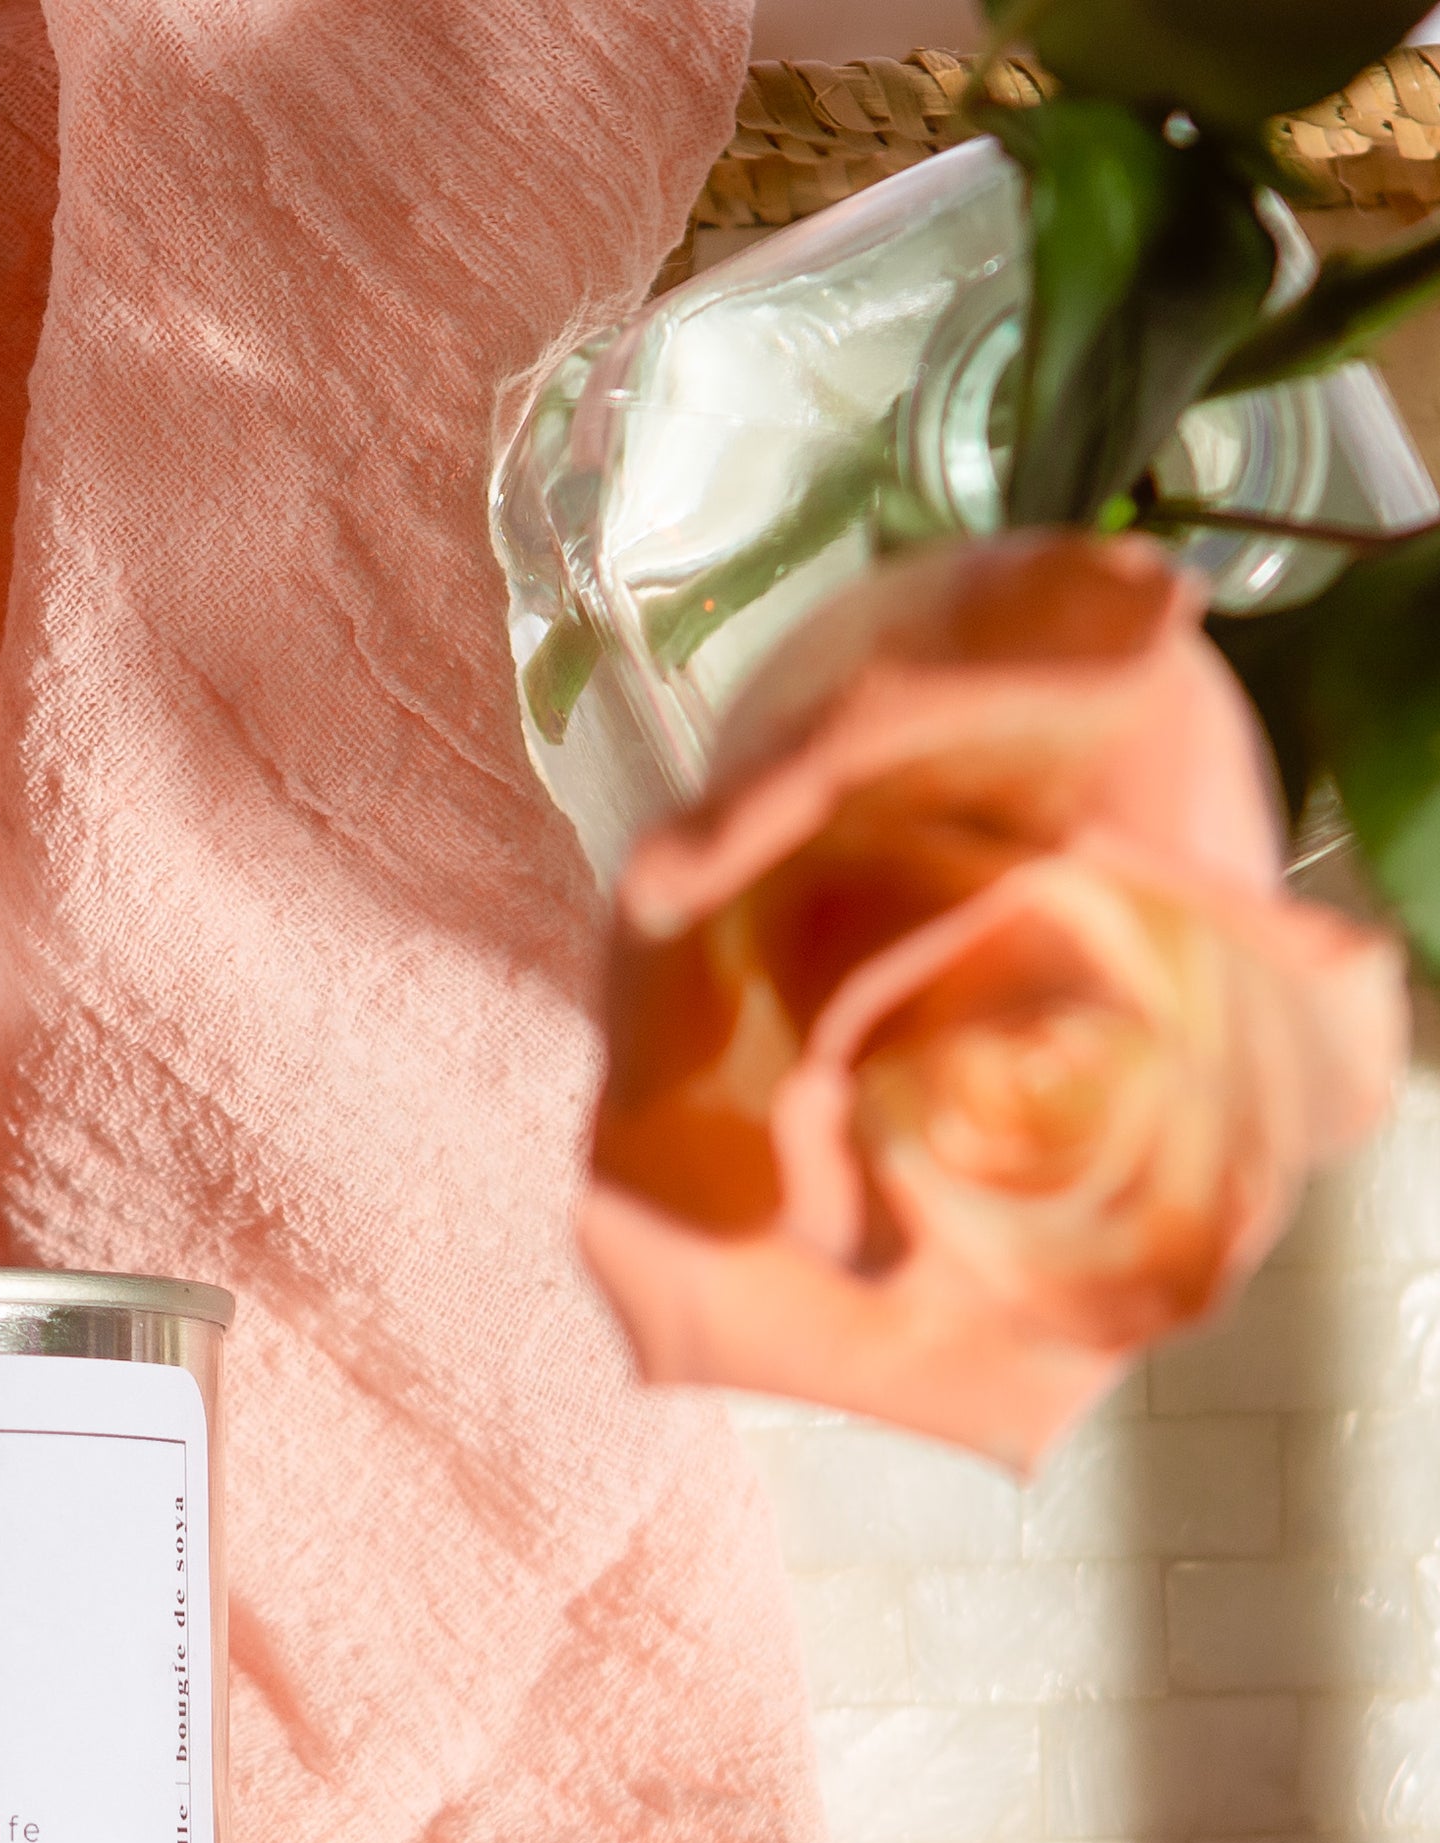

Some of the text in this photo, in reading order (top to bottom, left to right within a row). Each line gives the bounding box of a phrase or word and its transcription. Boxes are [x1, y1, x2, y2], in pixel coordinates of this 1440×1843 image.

[174, 1496, 187, 1573] soya
[173, 1588, 187, 1629] de
[175, 1643, 189, 1763] bougie
